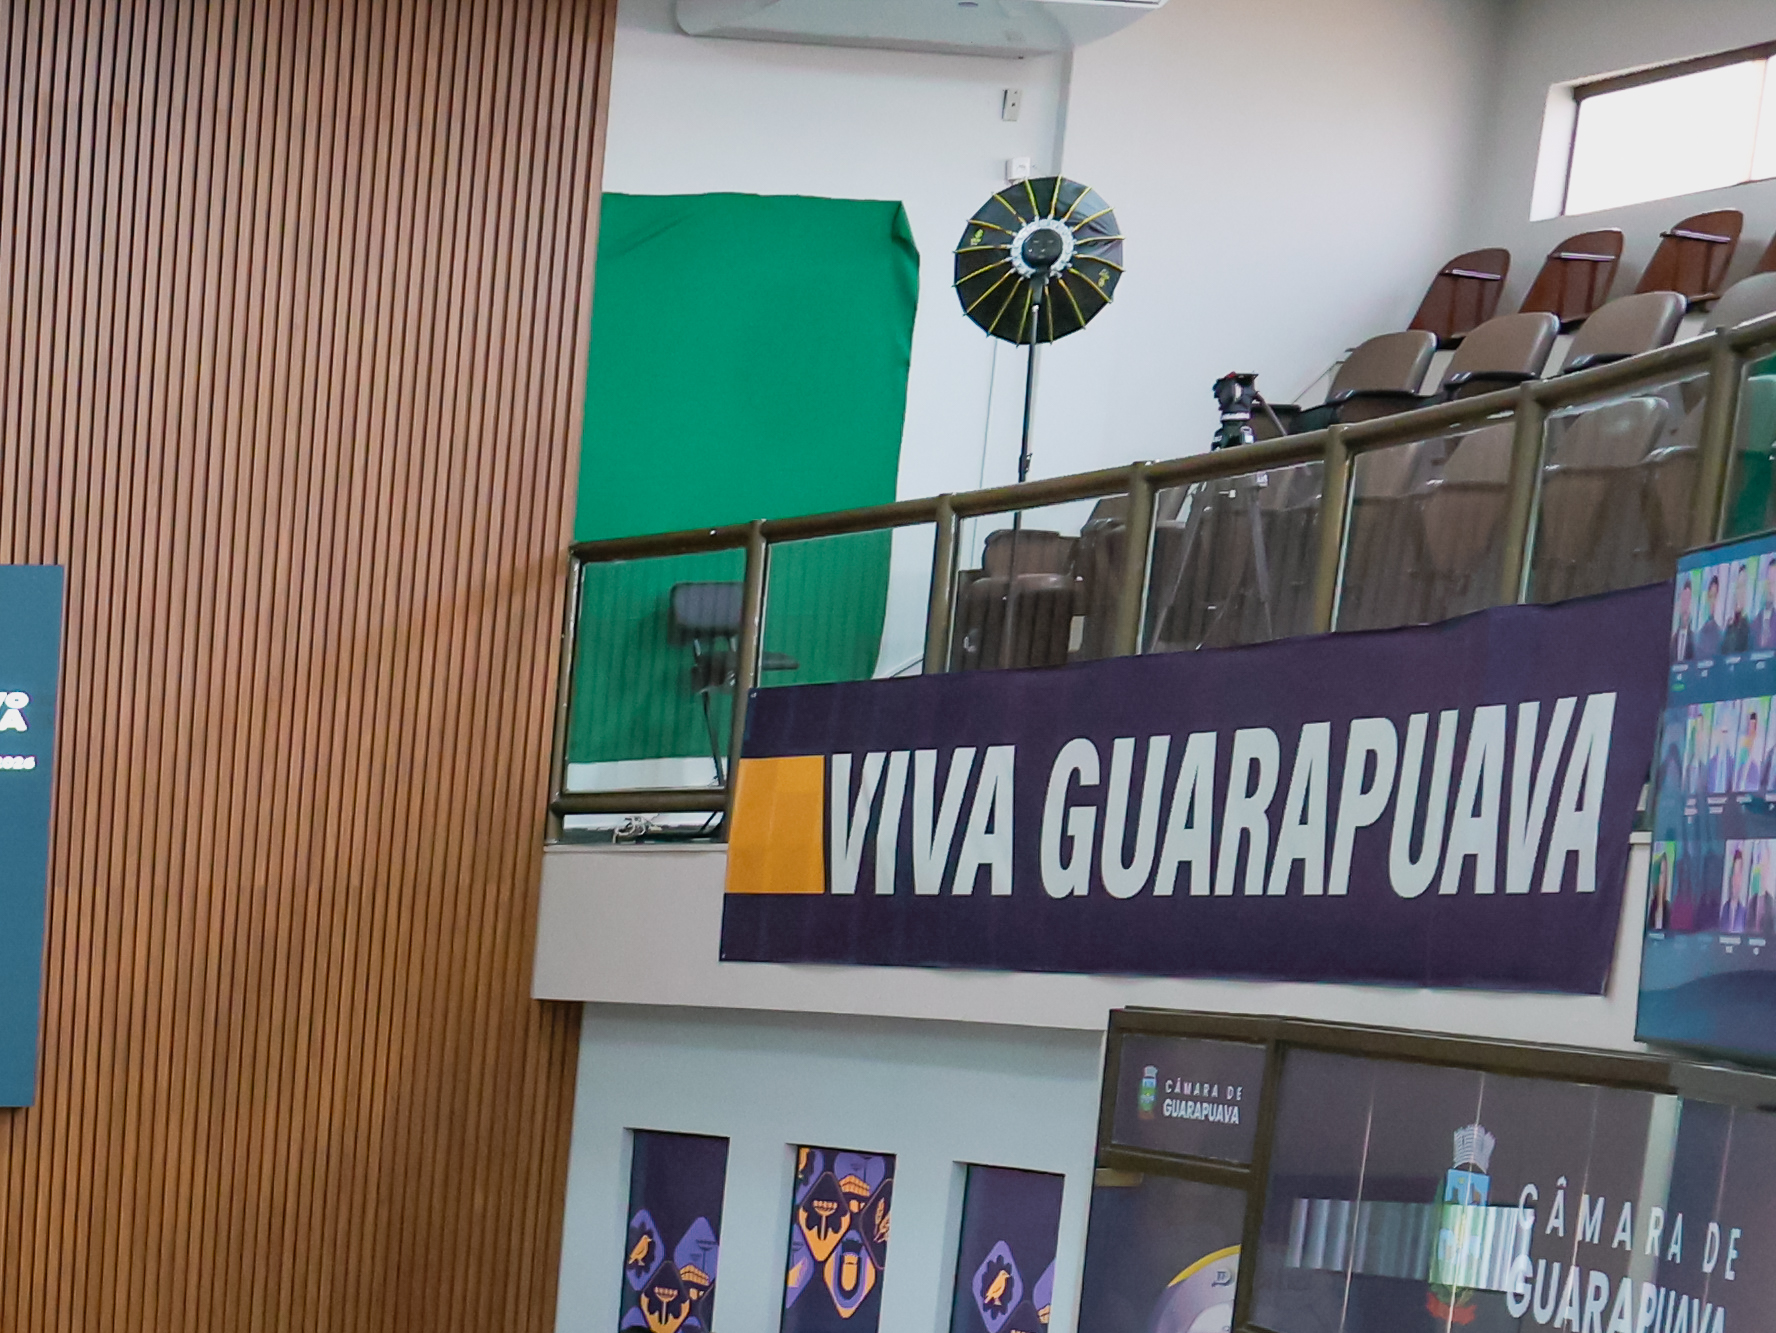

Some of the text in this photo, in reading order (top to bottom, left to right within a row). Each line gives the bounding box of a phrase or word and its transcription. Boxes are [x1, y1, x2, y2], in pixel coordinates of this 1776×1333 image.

[828, 692, 1617, 900] VIVA GUARAPUAVA
[1163, 1098, 1240, 1125] GUARAPUAVA
[1165, 1077, 1243, 1101] CÂMARA DE
[1518, 1175, 1742, 1281] CÂMARA DE
